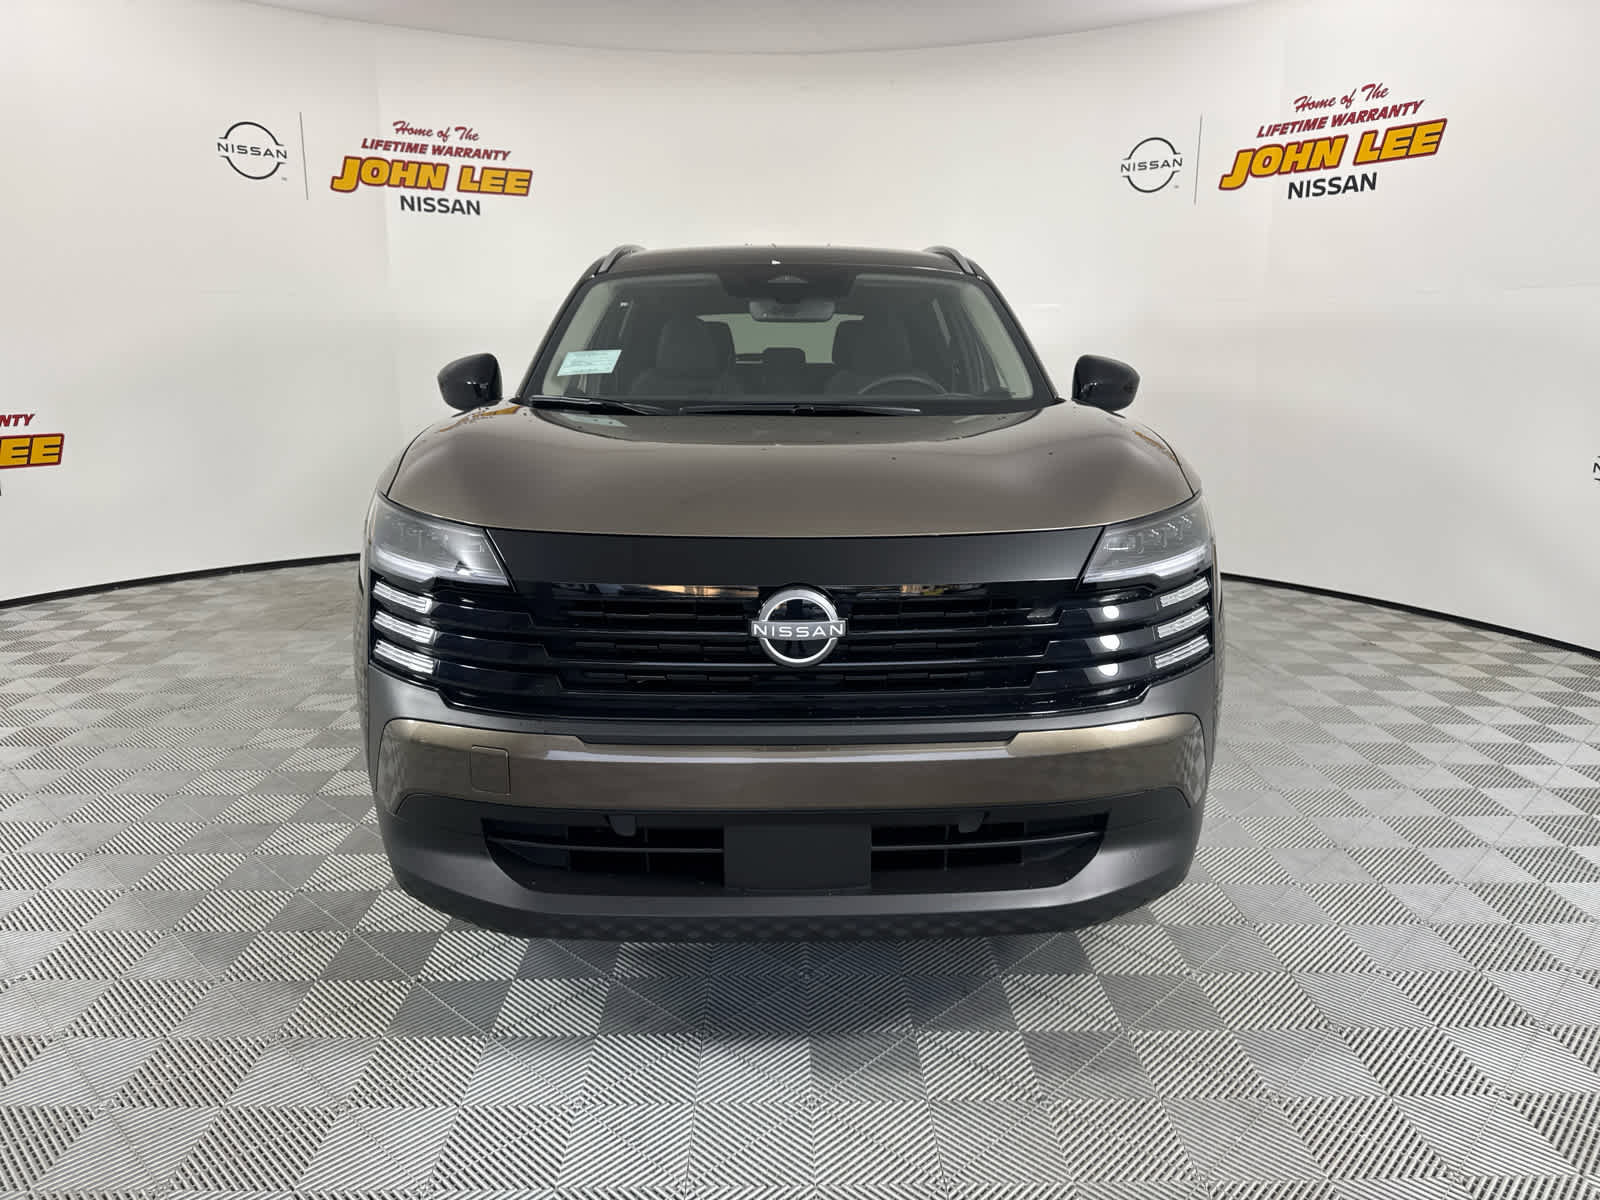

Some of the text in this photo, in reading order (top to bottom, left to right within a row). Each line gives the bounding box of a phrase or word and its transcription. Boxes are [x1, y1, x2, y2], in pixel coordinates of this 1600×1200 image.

[1293, 82, 1389, 113] Home of The
[1256, 100, 1424, 138] LIFETIME WARRANTY
[392, 120, 480, 142] Home of The
[217, 142, 288, 160] NISSAN
[361, 138, 512, 161] LIFETIME WARRANTY
[1218, 118, 1447, 191] JOHN LEE
[330, 156, 533, 197] JOHN LEE
[1120, 157, 1183, 173] NISSAN
[1287, 172, 1378, 200] NISSAN
[400, 195, 481, 216] NISSAN
[753, 623, 843, 638] NISSAN
